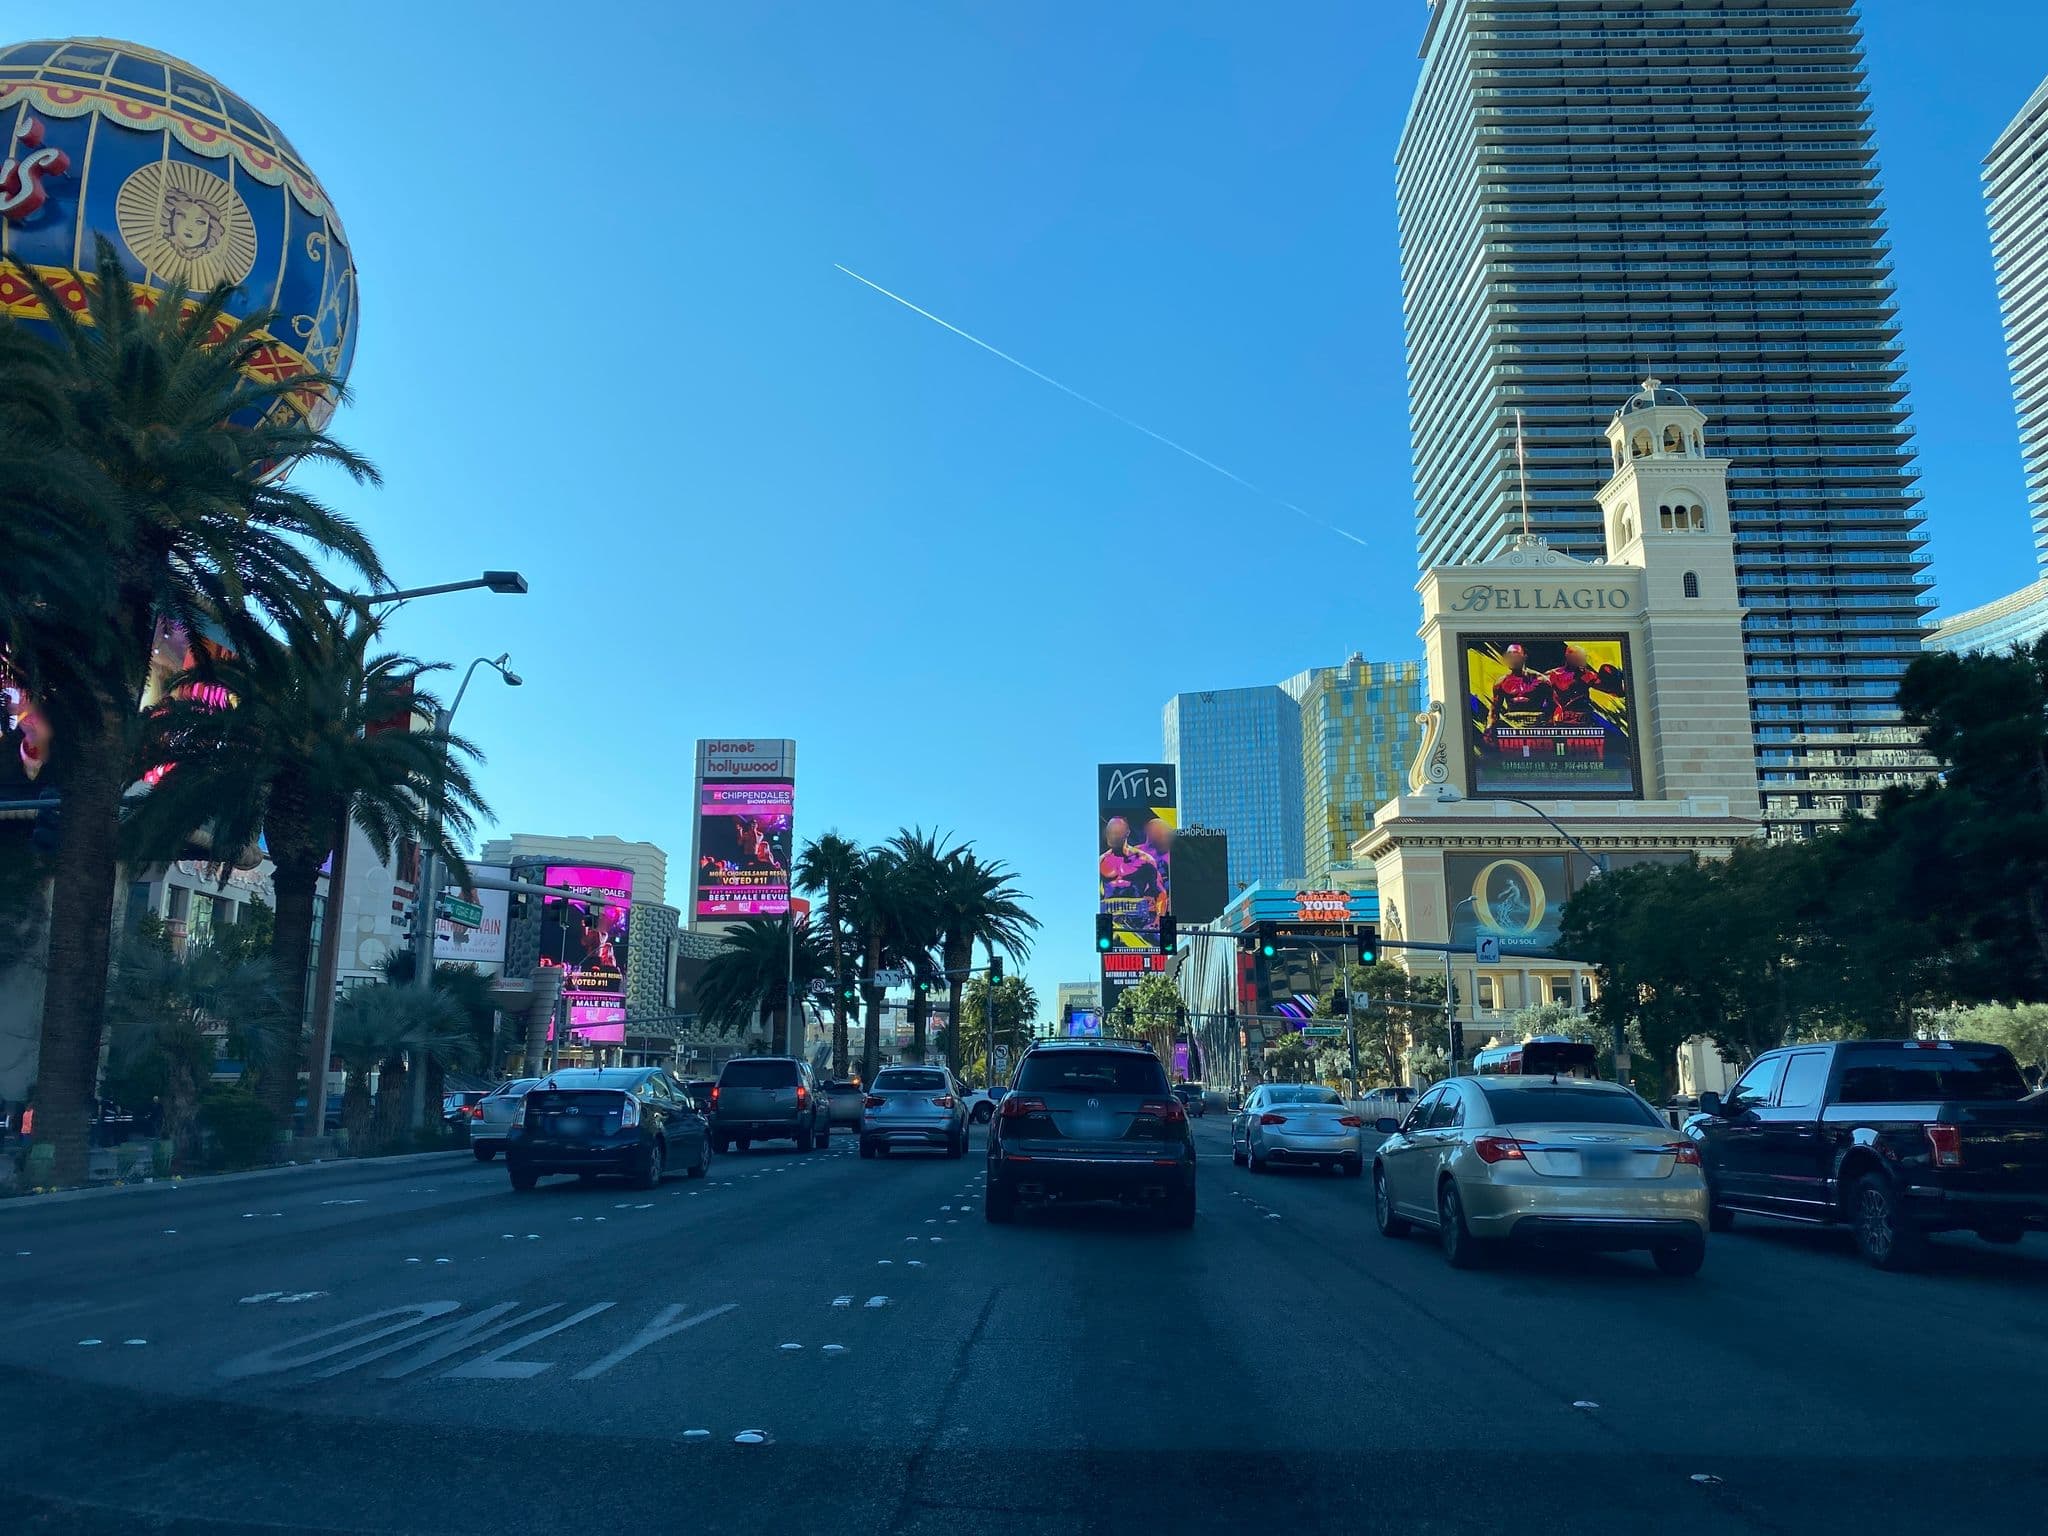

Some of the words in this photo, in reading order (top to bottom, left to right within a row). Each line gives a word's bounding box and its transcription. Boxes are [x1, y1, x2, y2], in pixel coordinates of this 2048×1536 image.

[1451, 585, 1630, 611] BELLAGIO
[708, 741, 755, 756] planet
[708, 760, 778, 775] hollywood
[1107, 769, 1168, 800] Aria
[722, 792, 790, 800] CHIPPENDALES
[723, 877, 752, 885] VOTED
[1303, 901, 1345, 910] YOUR
[572, 978, 596, 986] VOTED
[215, 1300, 740, 1380] ONLY
